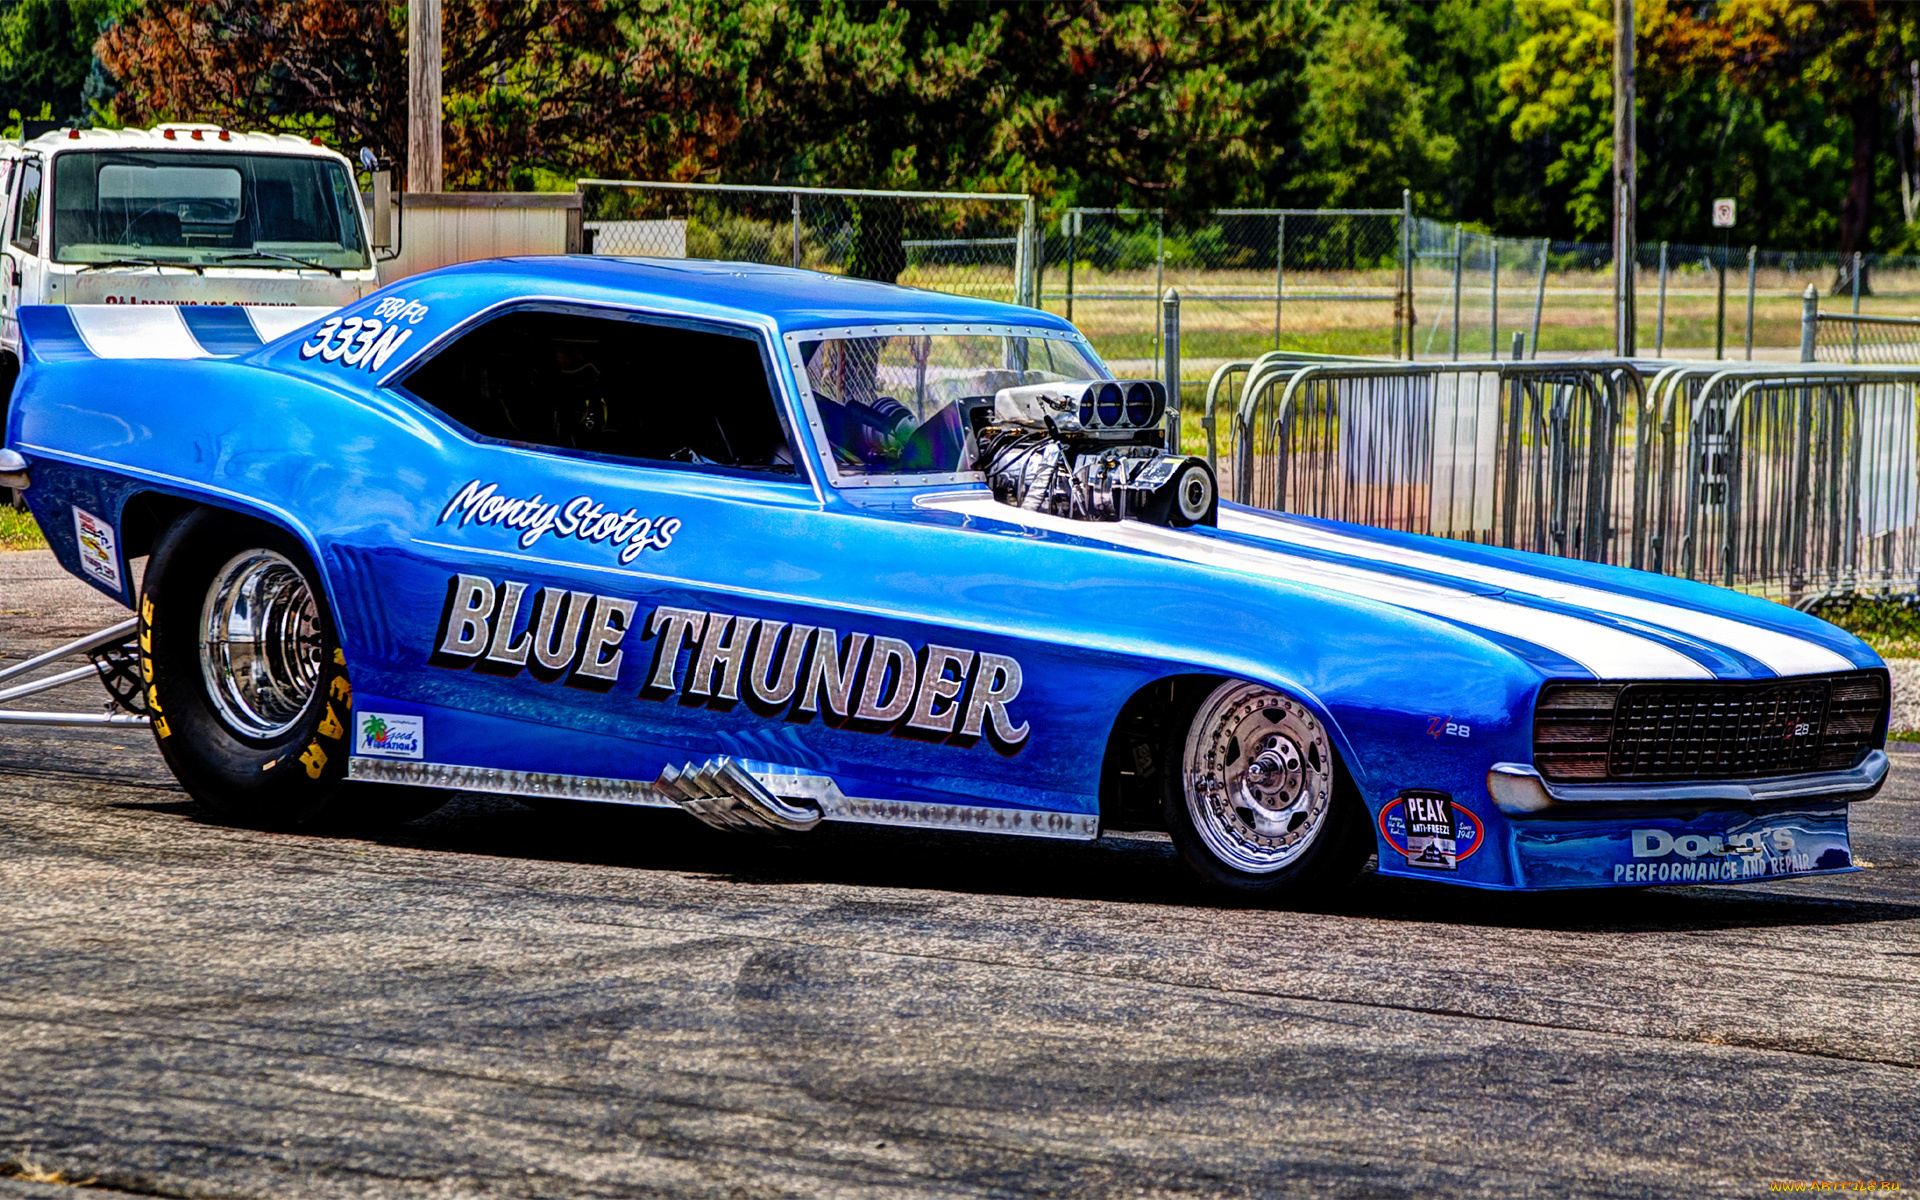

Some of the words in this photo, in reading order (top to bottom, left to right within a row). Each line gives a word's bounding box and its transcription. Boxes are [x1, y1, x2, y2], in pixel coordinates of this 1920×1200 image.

[300, 316, 413, 373] 333N
[438, 479, 560, 549] Monty
[429, 572, 639, 692] BLUE
[640, 605, 1031, 756] THUNDER
[1407, 797, 1449, 824] PEAK
[1613, 860, 1738, 882] PERFORMANCE
[1742, 857, 1767, 879] AND
[1770, 852, 1811, 875] REPAIR
